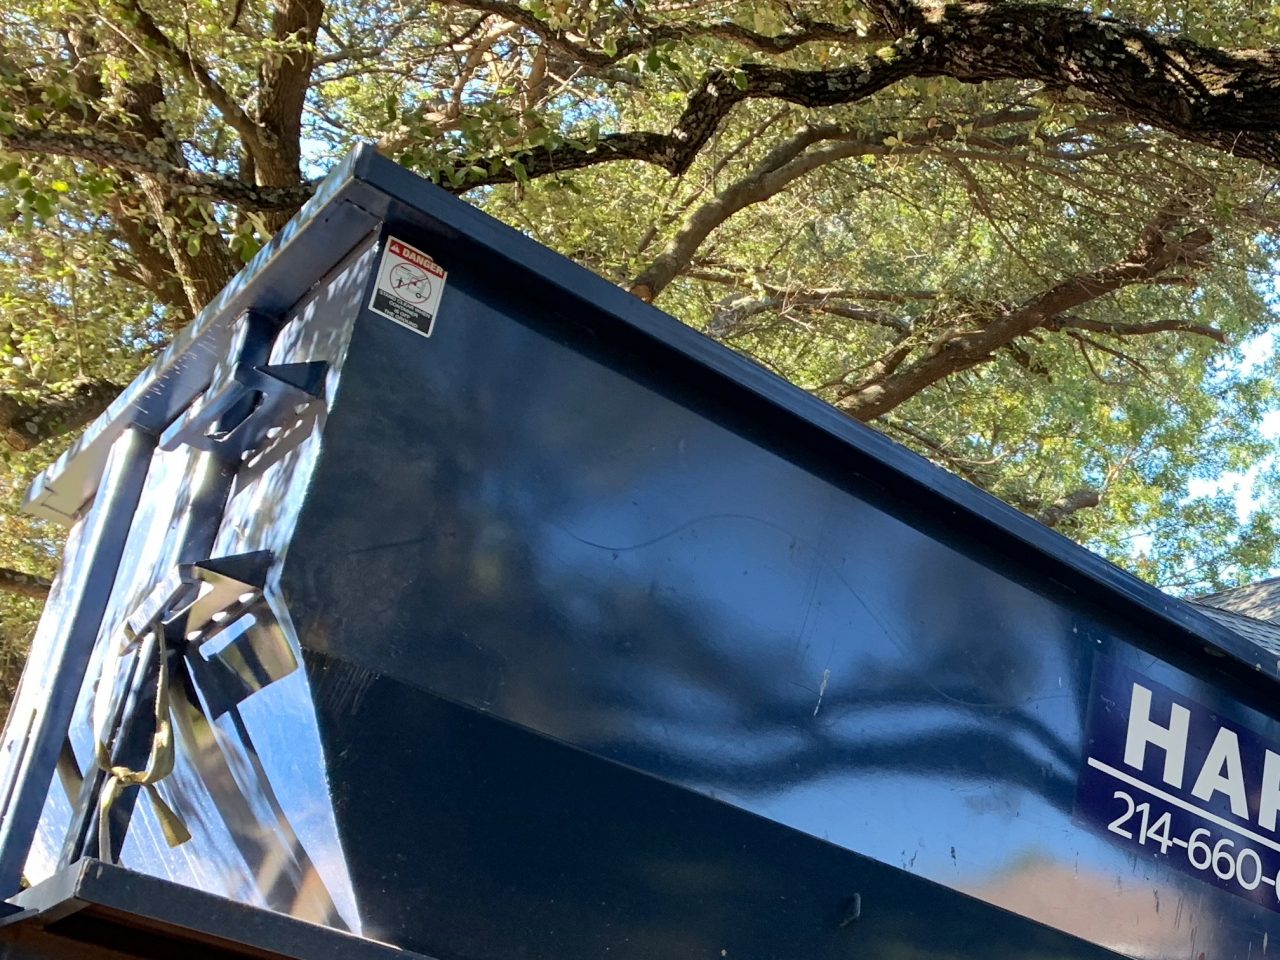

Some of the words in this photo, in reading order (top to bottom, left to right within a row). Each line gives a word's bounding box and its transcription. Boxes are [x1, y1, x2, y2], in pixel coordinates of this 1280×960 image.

[402, 247, 443, 277] DANGER
[379, 290, 397, 302] STAND
[397, 298, 415, 311] CLEAR
[415, 307, 431, 319] WHEN
[389, 300, 419, 319] CONTAINER
[384, 308, 396, 317] THE
[395, 314, 418, 328] GROUND
